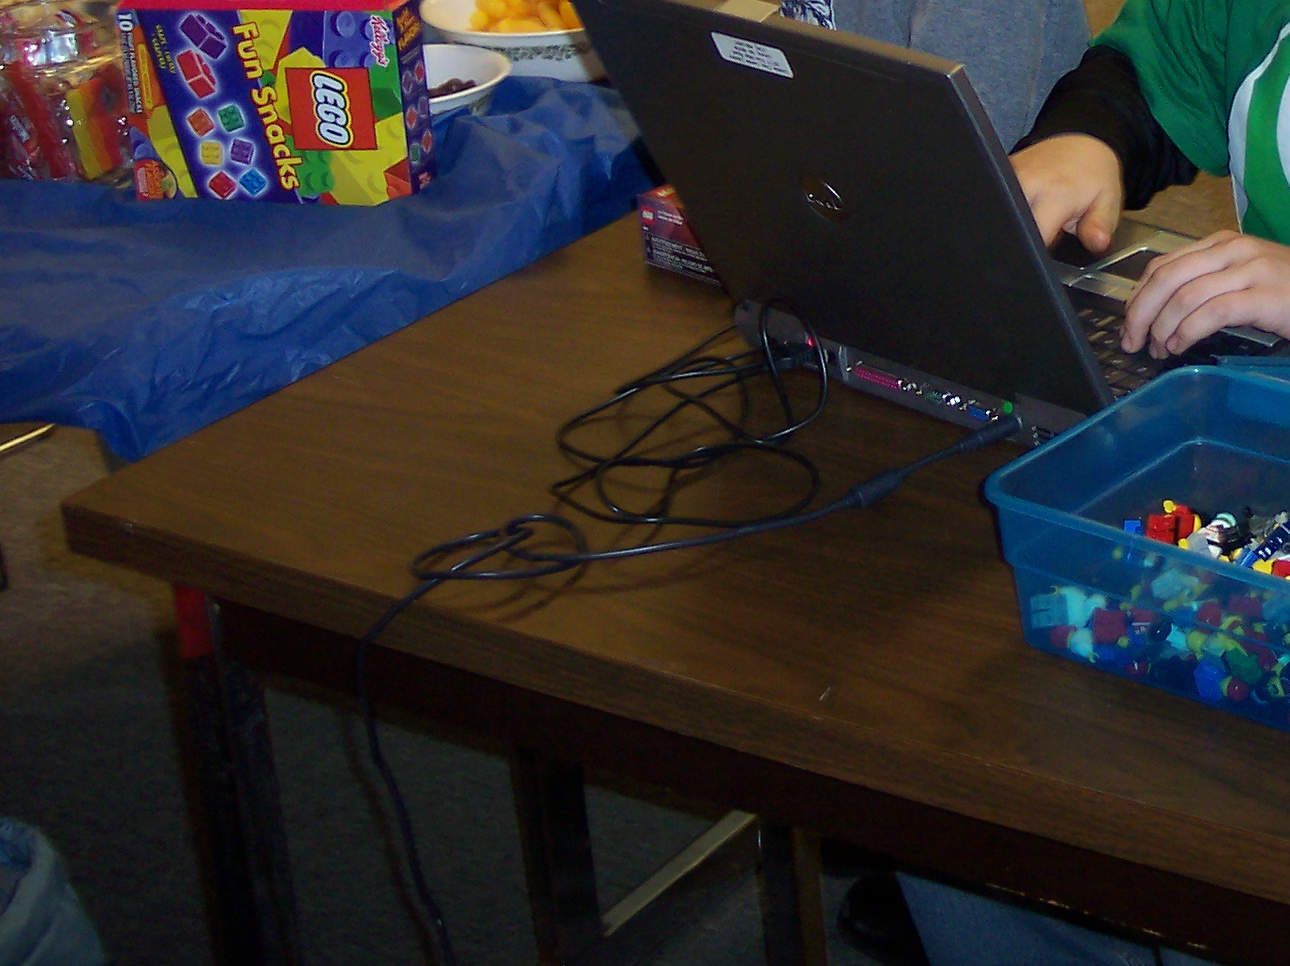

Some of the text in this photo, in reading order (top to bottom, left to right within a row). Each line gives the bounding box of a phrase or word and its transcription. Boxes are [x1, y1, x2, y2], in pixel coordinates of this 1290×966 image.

[118, 13, 134, 32] 10
[369, 15, 390, 68] Kellogg's
[232, 22, 303, 191] Fun Snacks
[311, 71, 353, 147] LEGO
